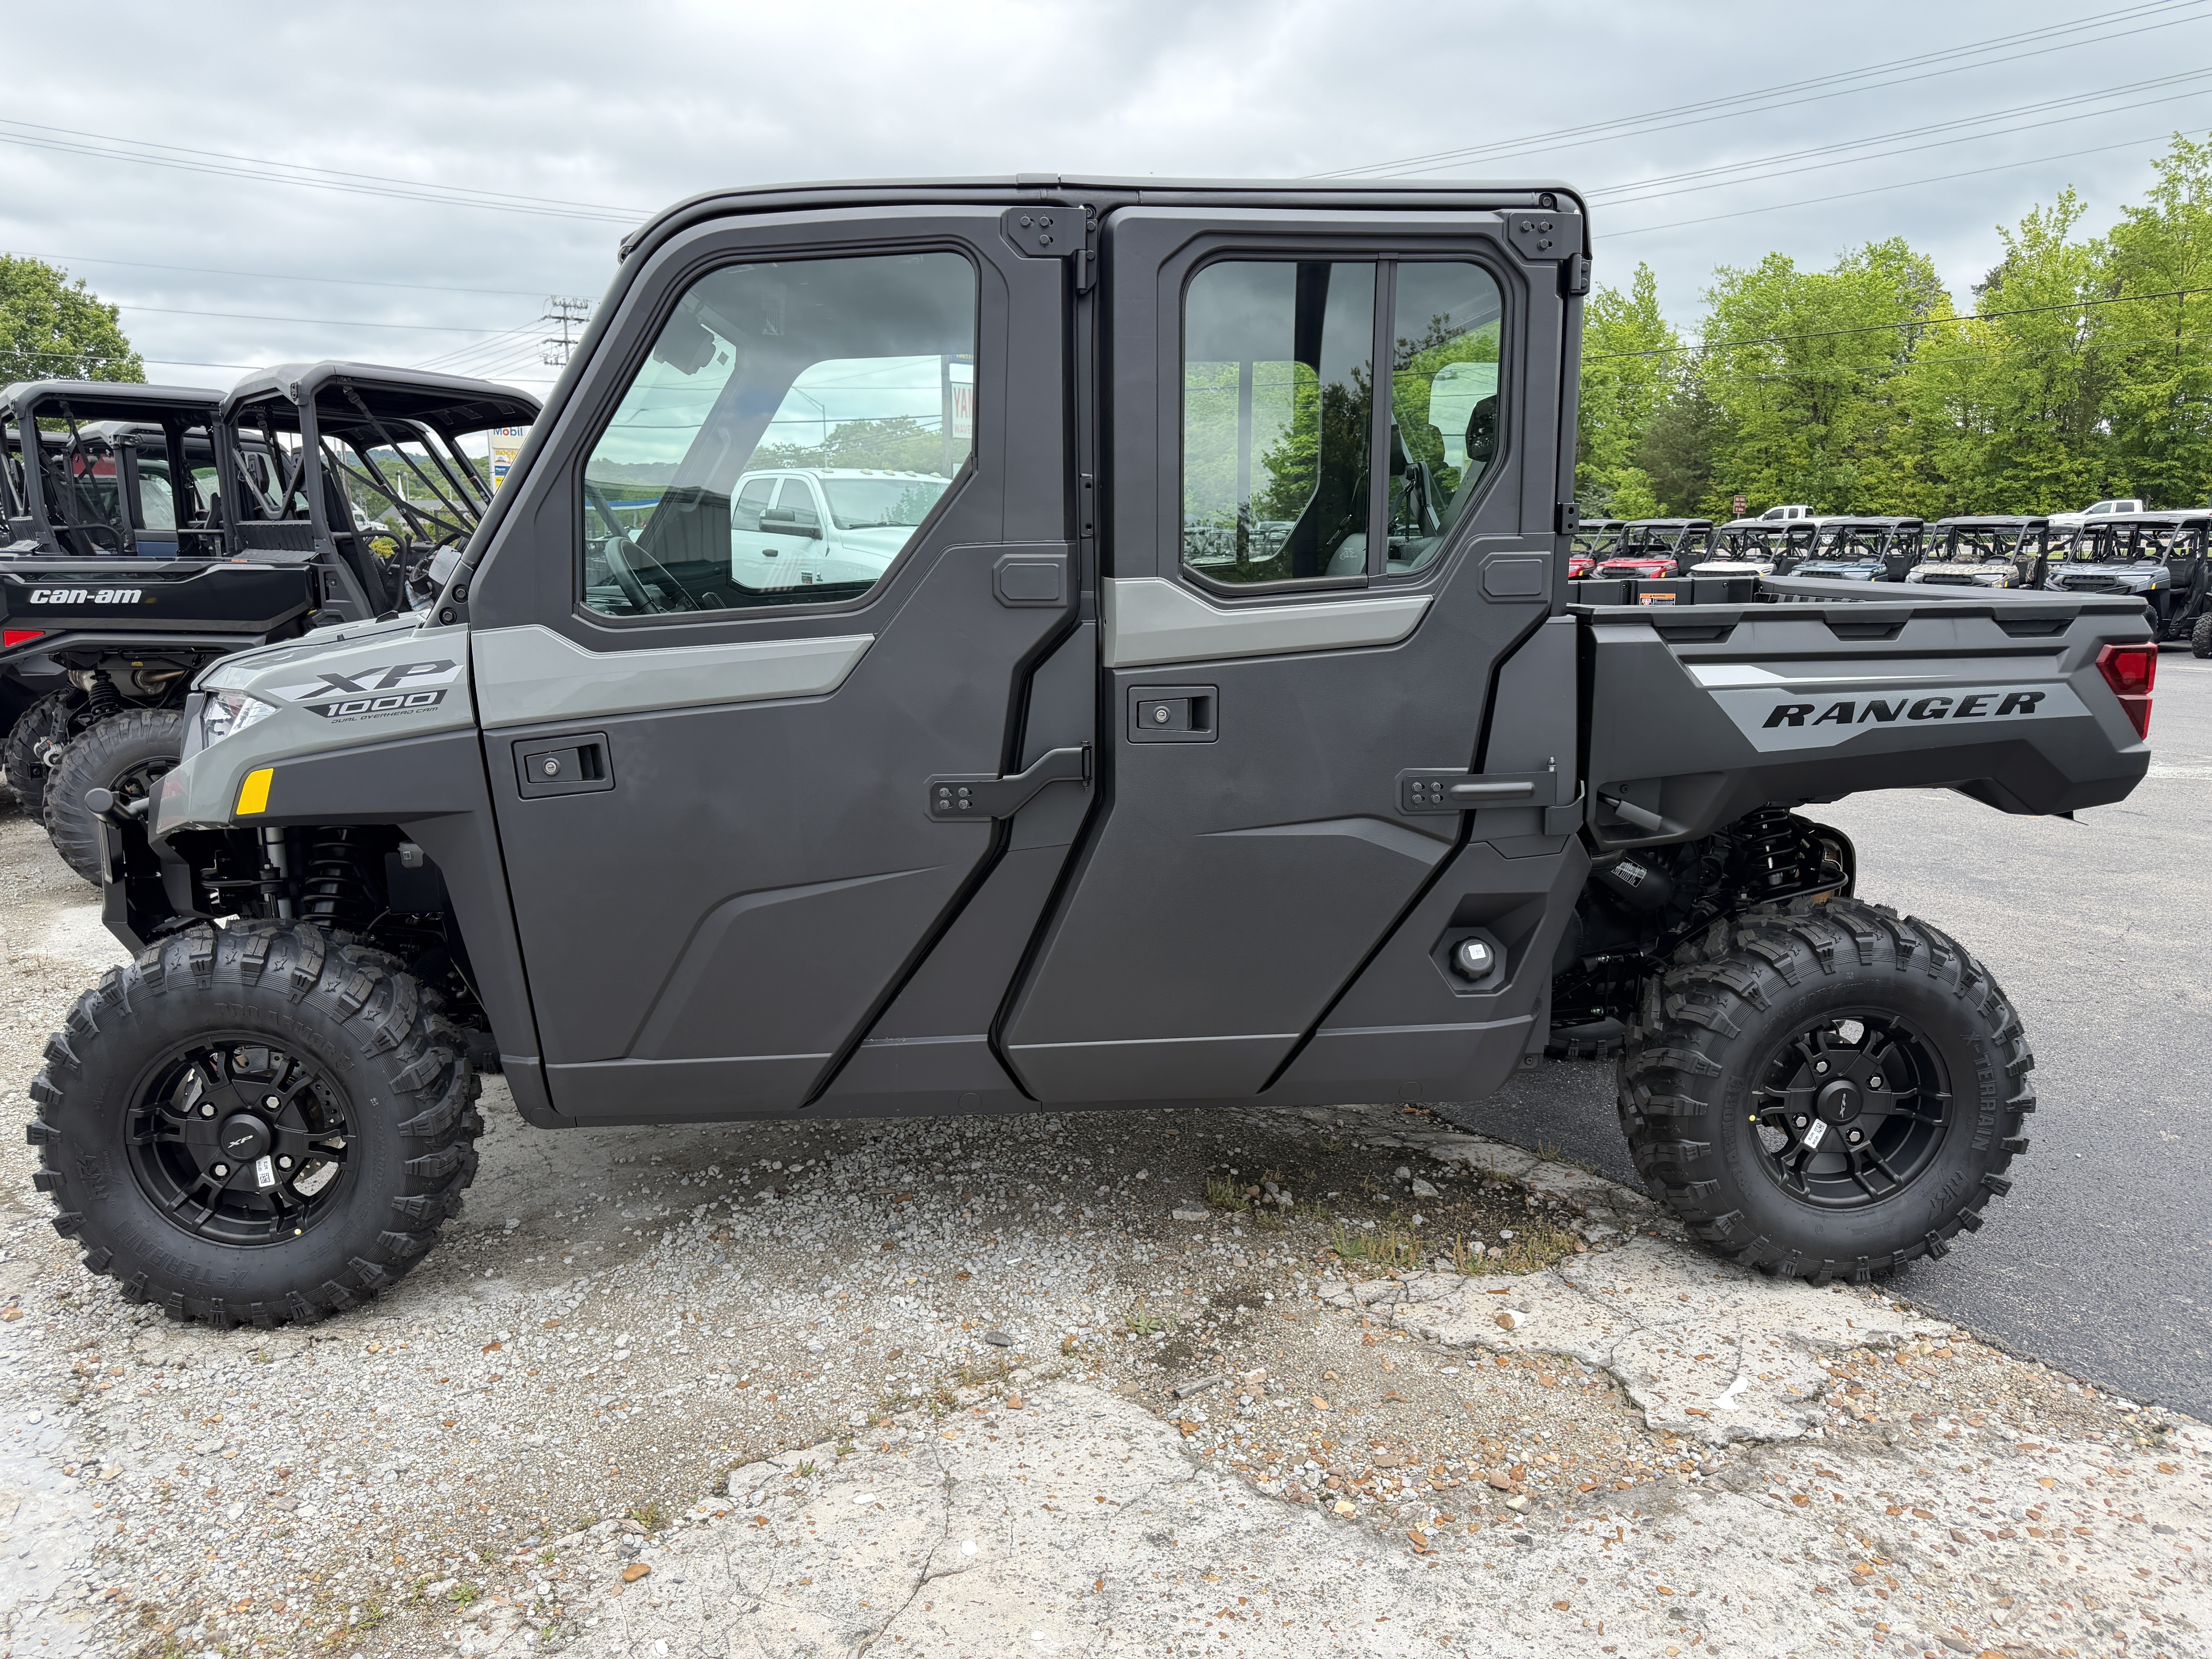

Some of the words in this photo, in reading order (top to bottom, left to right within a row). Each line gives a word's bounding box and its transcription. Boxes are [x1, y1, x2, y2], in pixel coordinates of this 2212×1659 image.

[493, 427, 523, 436] Mobil
[30, 589, 142, 603] can-am
[294, 659, 457, 700] XP
[327, 692, 438, 716] 1000
[361, 710, 413, 720] OVERHEAD
[1761, 691, 2046, 728] RANGER
[1960, 1030, 1997, 1151] X-TERRAIN
[1839, 1093, 1846, 1118] XP
[228, 1135, 253, 1148] XP
[1722, 1096, 1739, 1163] ARMOR
[113, 1221, 248, 1289] X-TERRAIN
